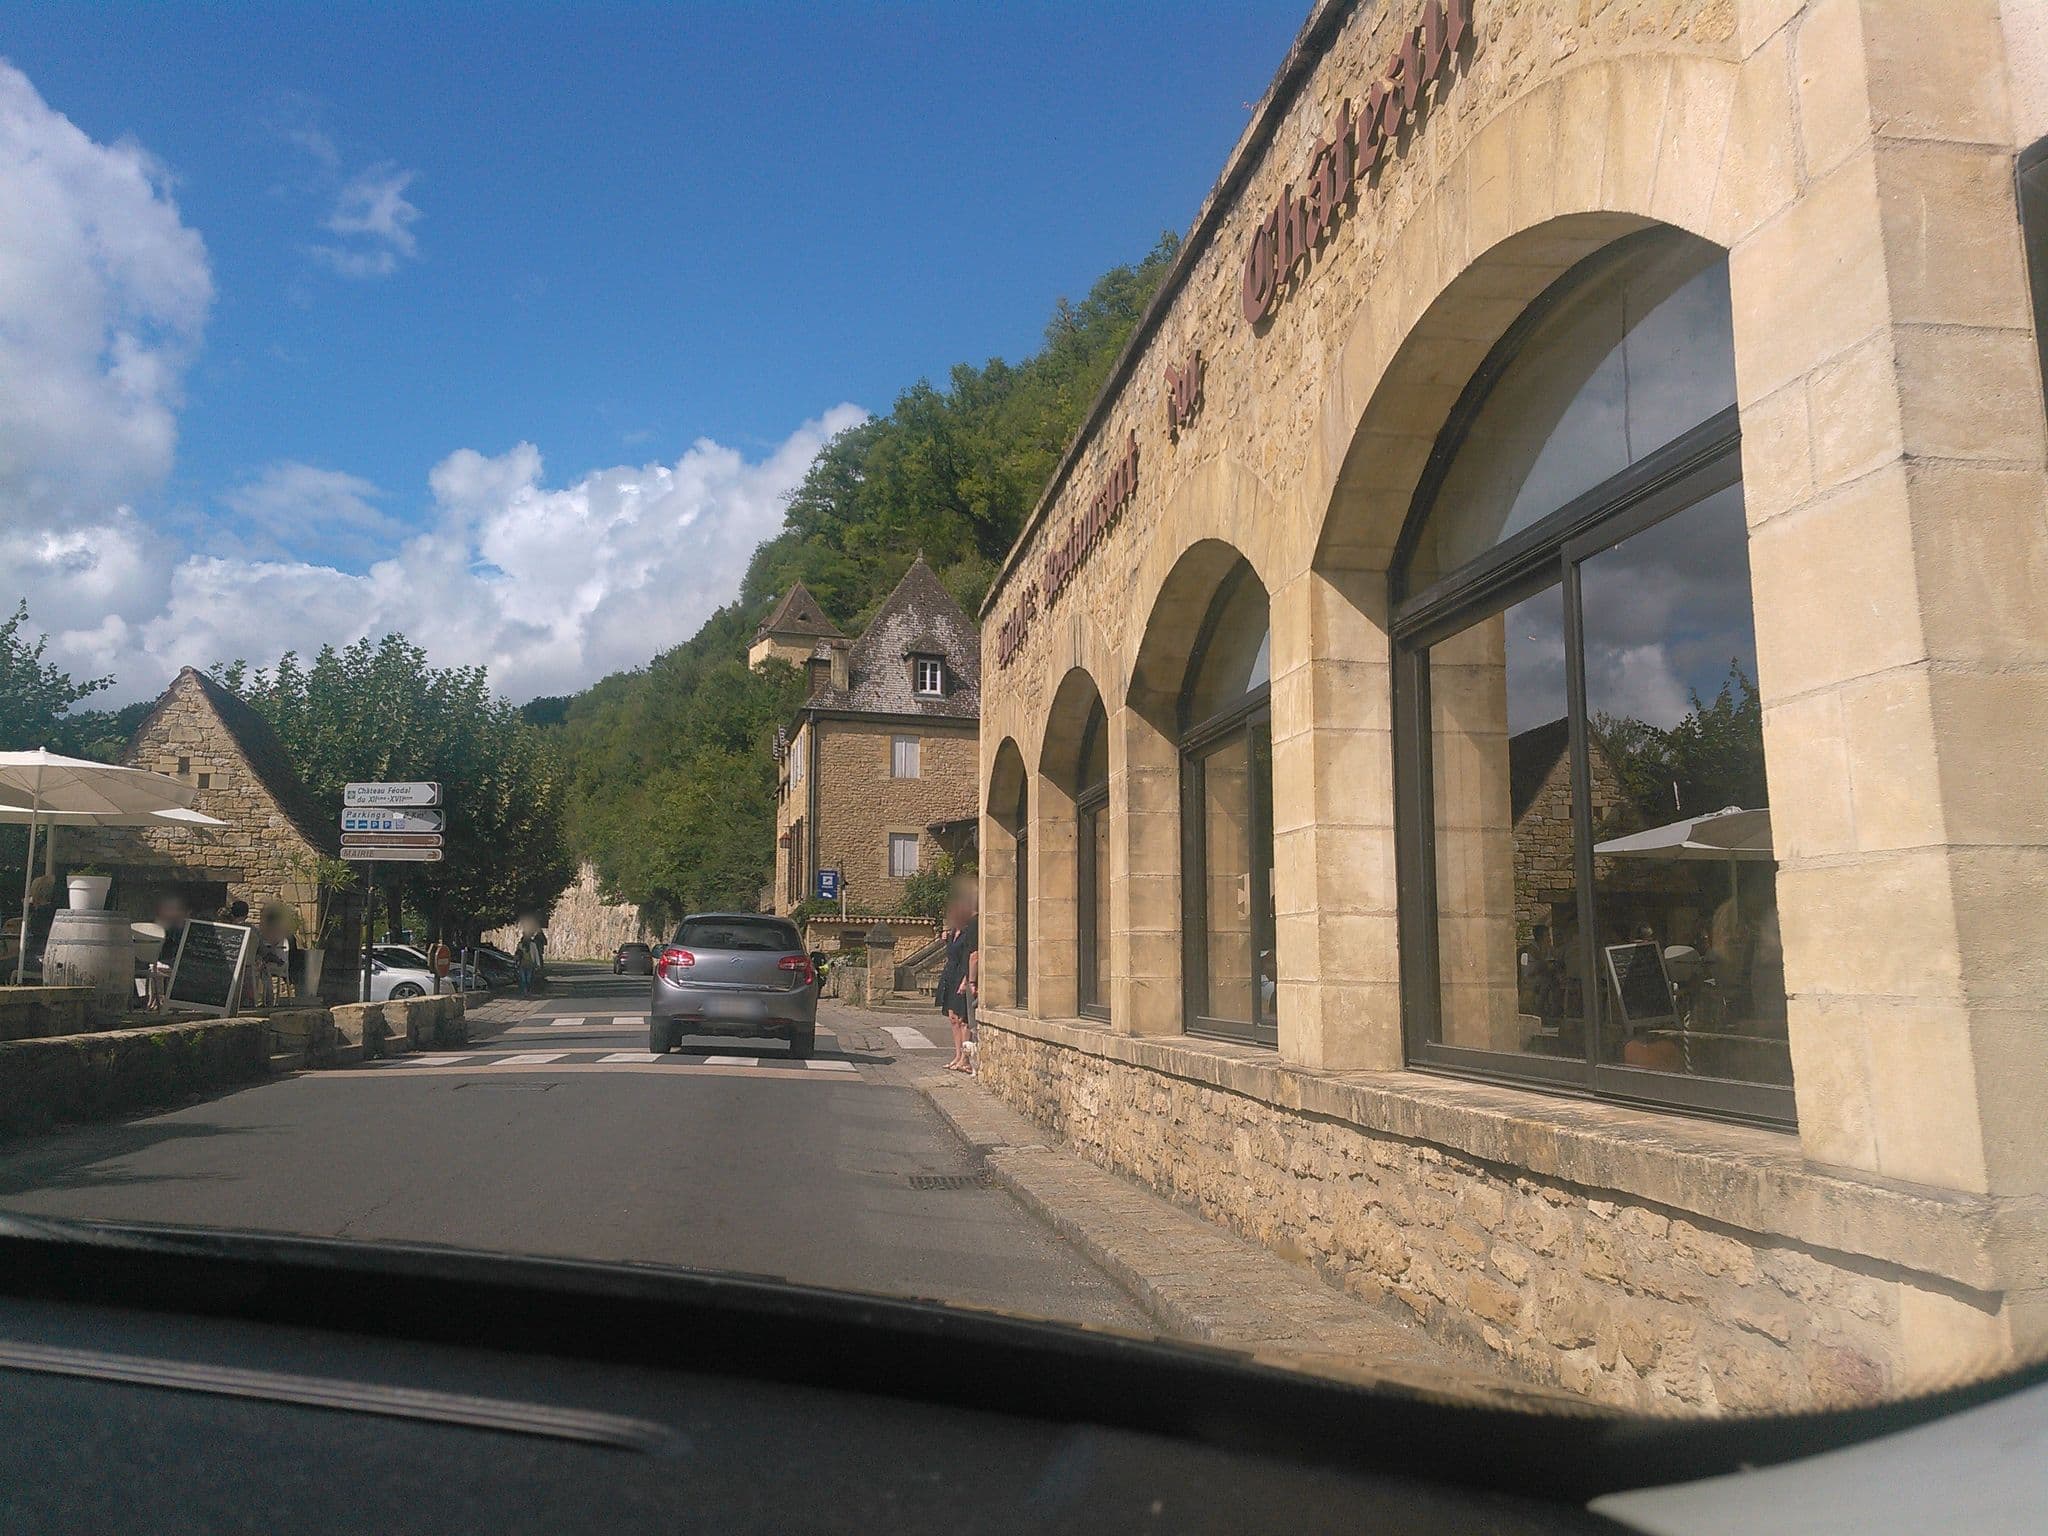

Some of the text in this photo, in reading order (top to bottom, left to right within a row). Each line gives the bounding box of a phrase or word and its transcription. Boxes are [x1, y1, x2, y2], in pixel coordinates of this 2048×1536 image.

[388, 786, 411, 794] Féodal
[346, 811, 386, 819] Parkings
[343, 849, 374, 857] MAIRIE
